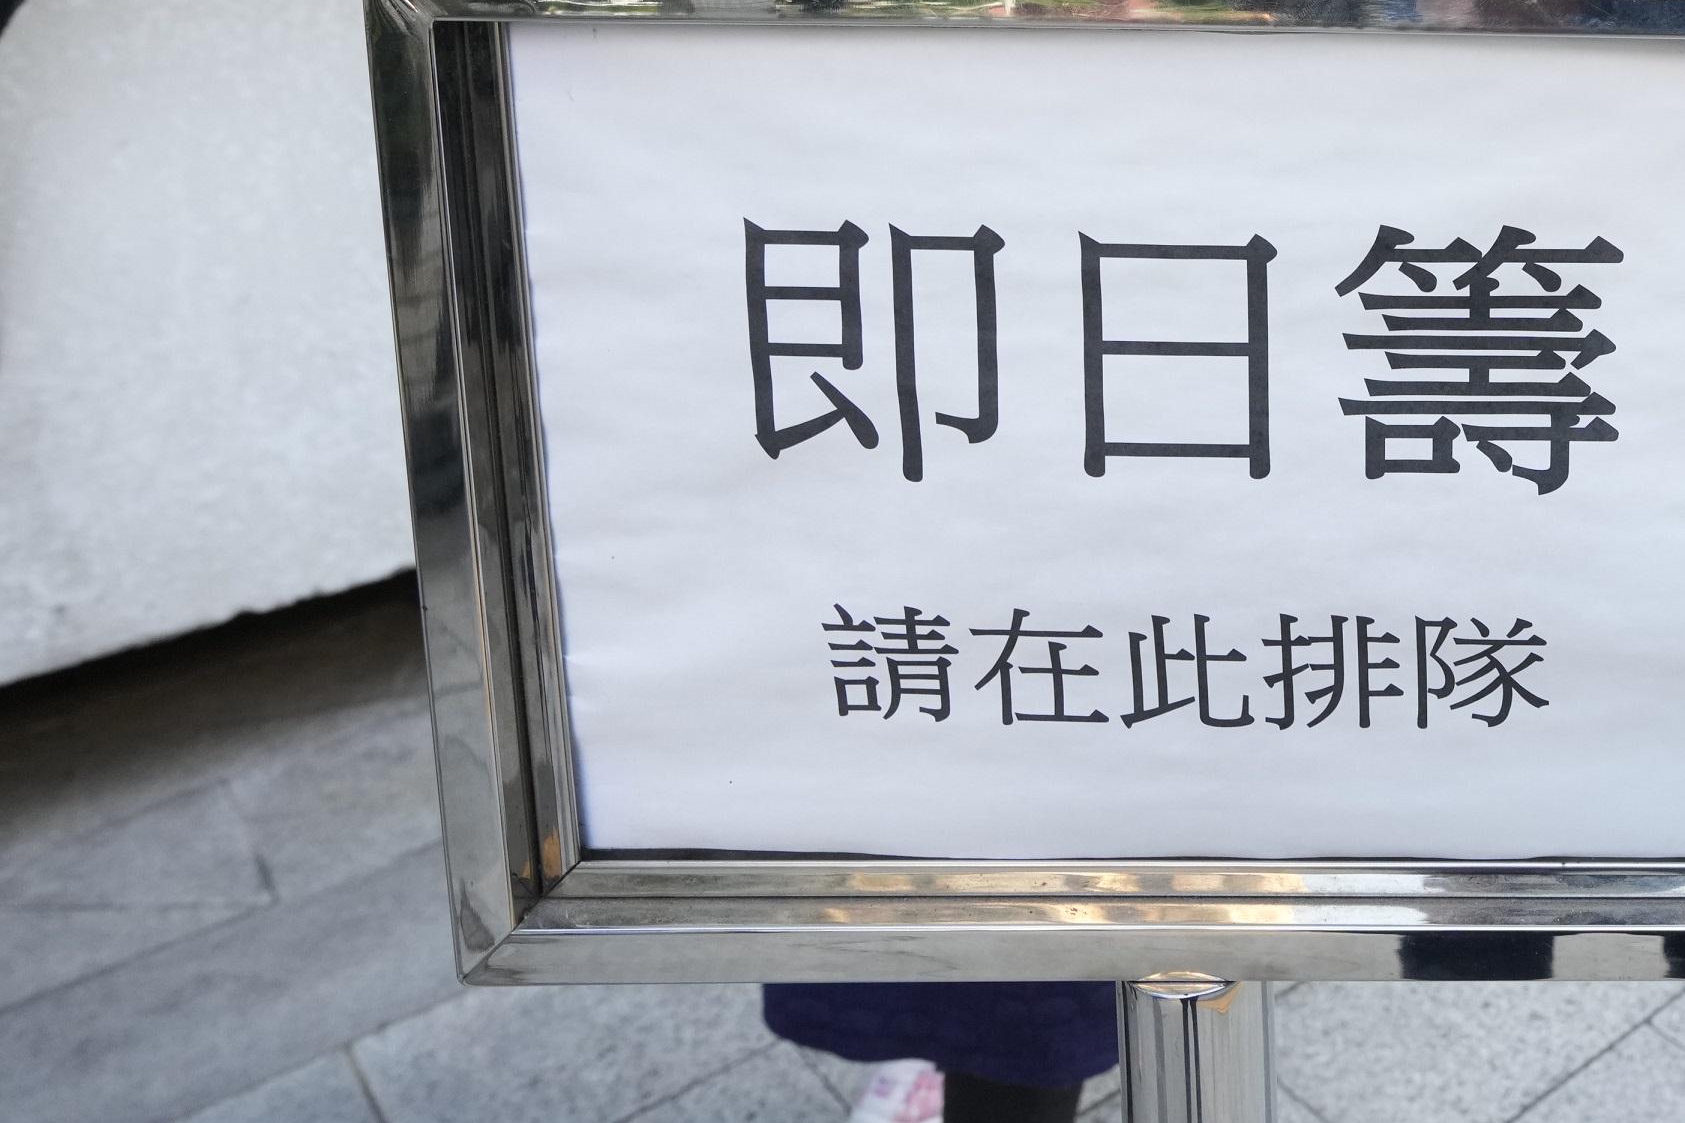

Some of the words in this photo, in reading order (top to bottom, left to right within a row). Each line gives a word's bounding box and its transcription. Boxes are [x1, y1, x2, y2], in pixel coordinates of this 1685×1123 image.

[743, 217, 1624, 495] 即日籌
[821, 603, 1550, 731] 請在此排隊
